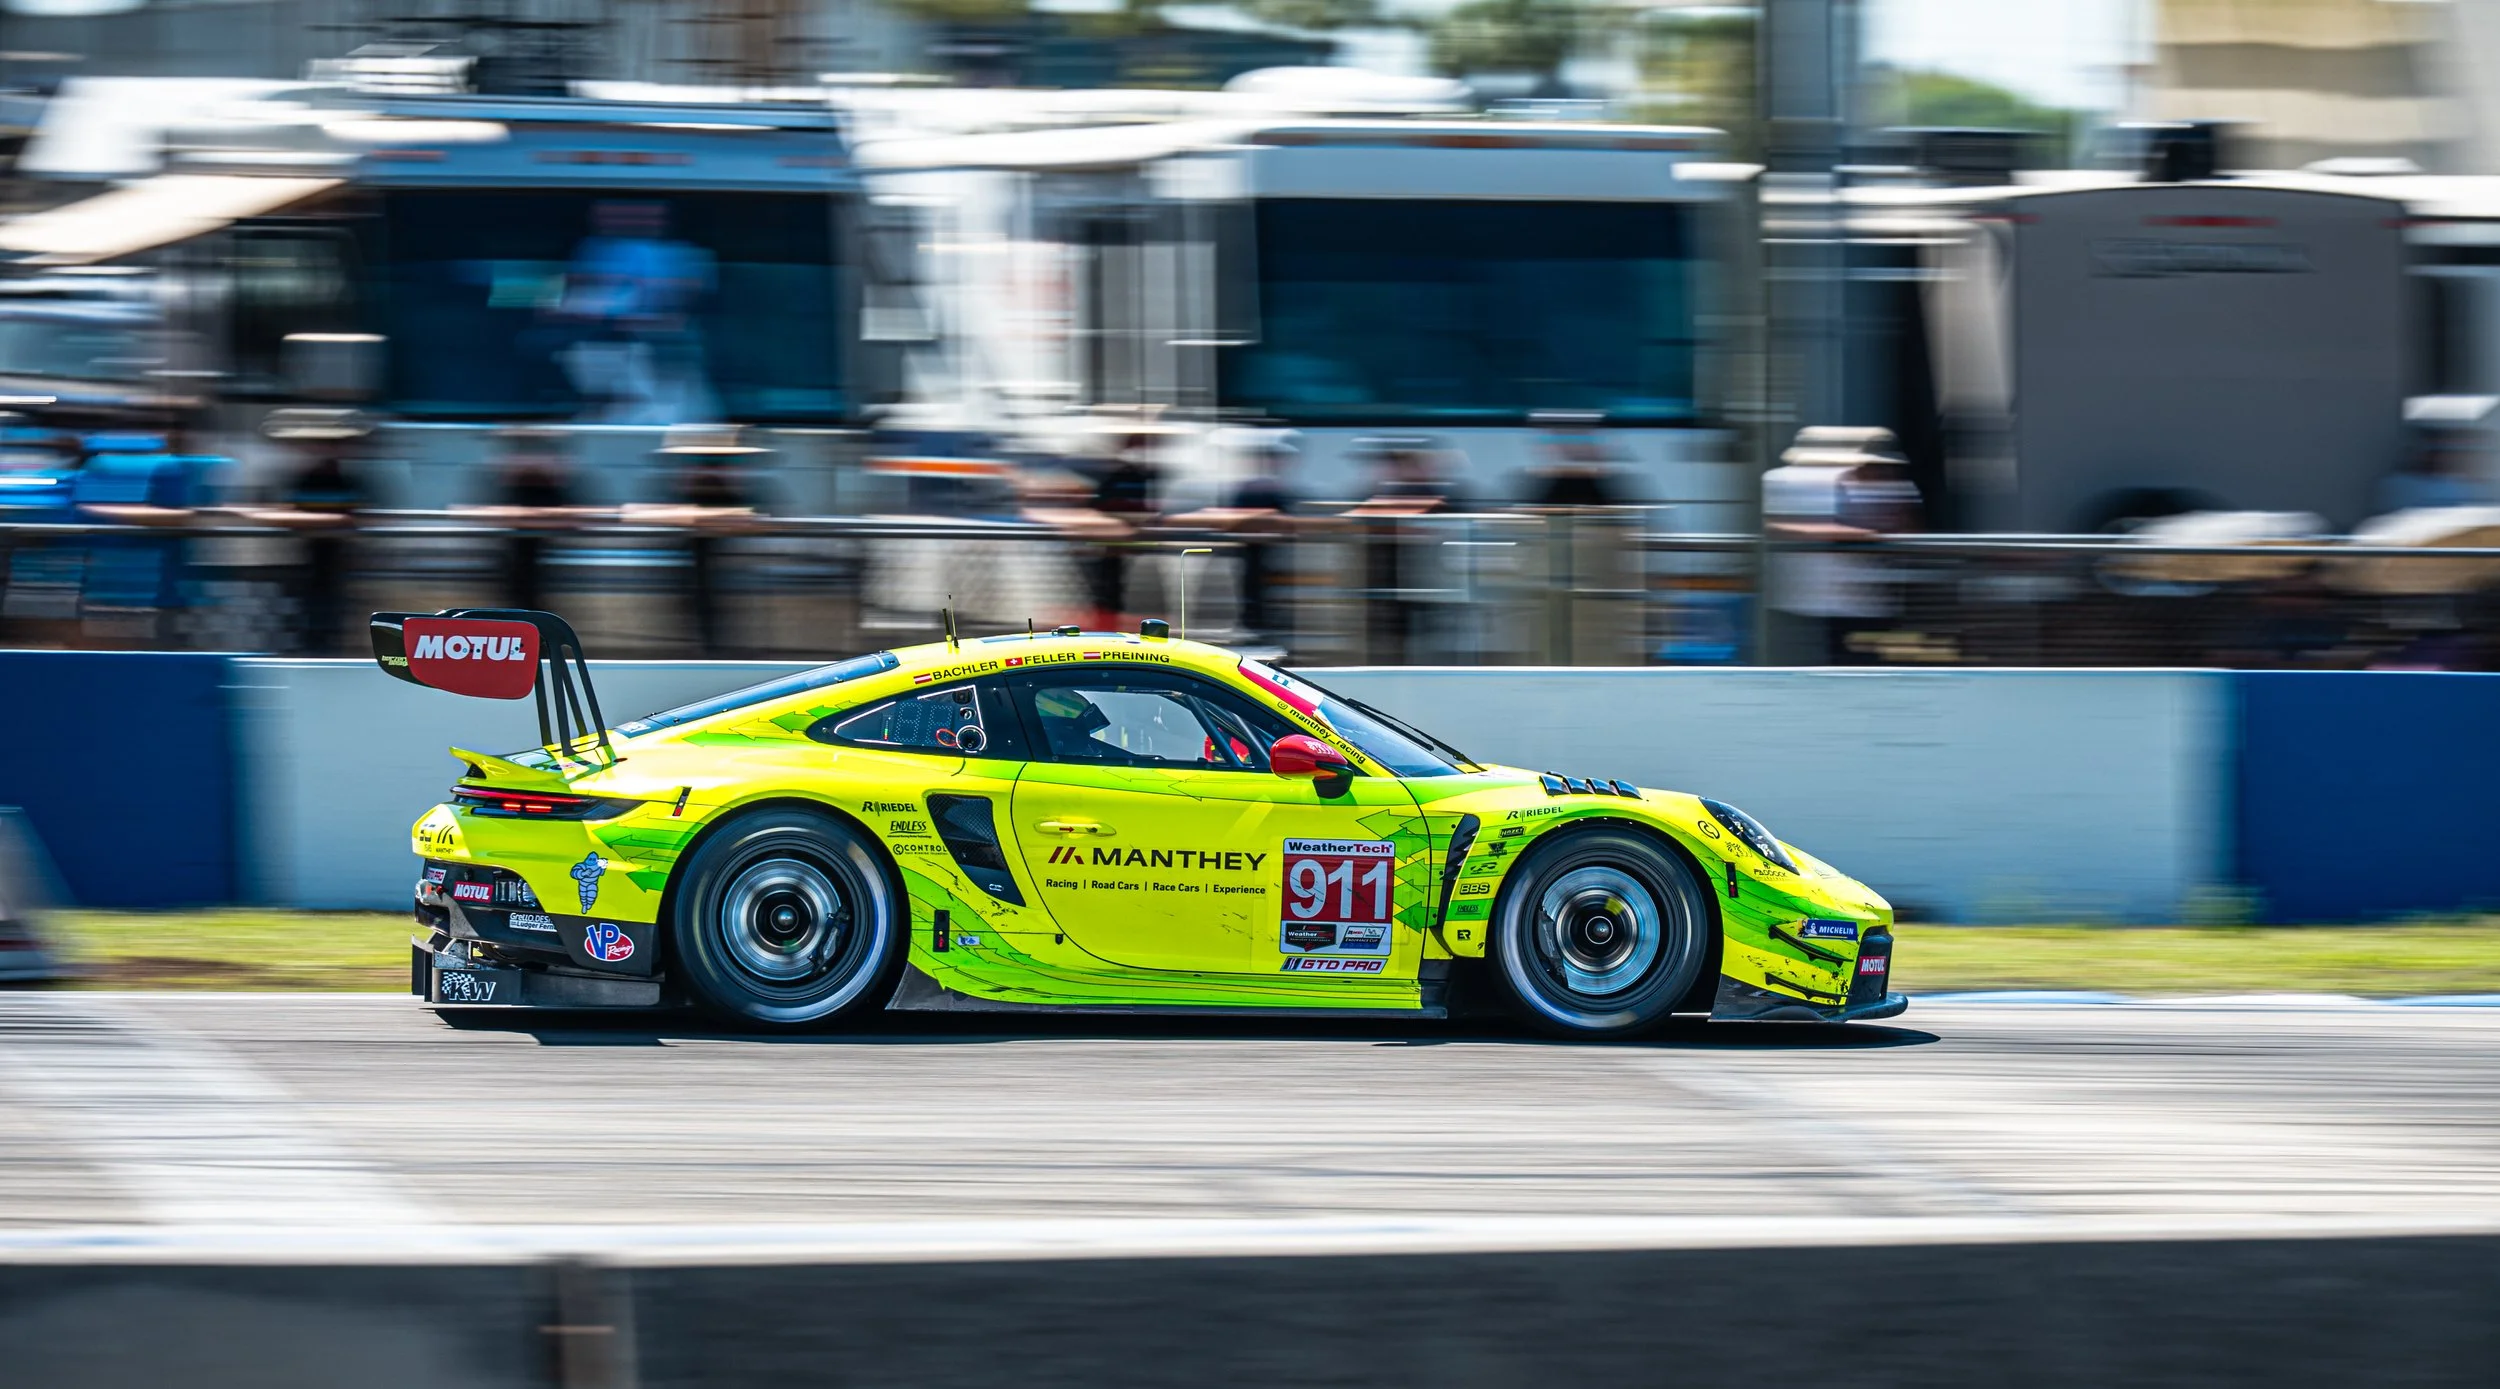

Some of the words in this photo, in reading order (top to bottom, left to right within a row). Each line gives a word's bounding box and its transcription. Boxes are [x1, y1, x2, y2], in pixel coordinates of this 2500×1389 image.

[414, 635, 526, 661] MOTUL
[1024, 652, 1076, 665] FELLER
[1102, 651, 1170, 664] PREINING
[932, 660, 999, 681] BACHLER
[1289, 708, 1367, 764] manthey_racing
[882, 801, 918, 812] RIEDEL
[1526, 806, 1564, 817] RIEDEL
[890, 820, 927, 831] ENDLESS
[904, 844, 947, 852] CONTROL
[1288, 841, 1391, 853] WeatherTech
[1092, 847, 1267, 871] MANTHEY
[454, 883, 490, 900] MOTUL
[1046, 878, 1078, 890] Racing
[1091, 880, 1115, 890] Road
[1117, 881, 1139, 891] Cars
[1152, 882, 1176, 892] Race
[1178, 883, 1200, 893] Cars
[1213, 884, 1266, 895] Experience
[1289, 859, 1388, 920] 911
[1460, 883, 1490, 895] BBS
[1818, 926, 1854, 935] MICHELIN
[585, 923, 621, 961] VP
[607, 944, 632, 957] Racing
[1301, 959, 1340, 969] GTD
[1342, 961, 1382, 971] PRO
[1861, 958, 1885, 972] MOTUL
[449, 981, 497, 1001] KW
